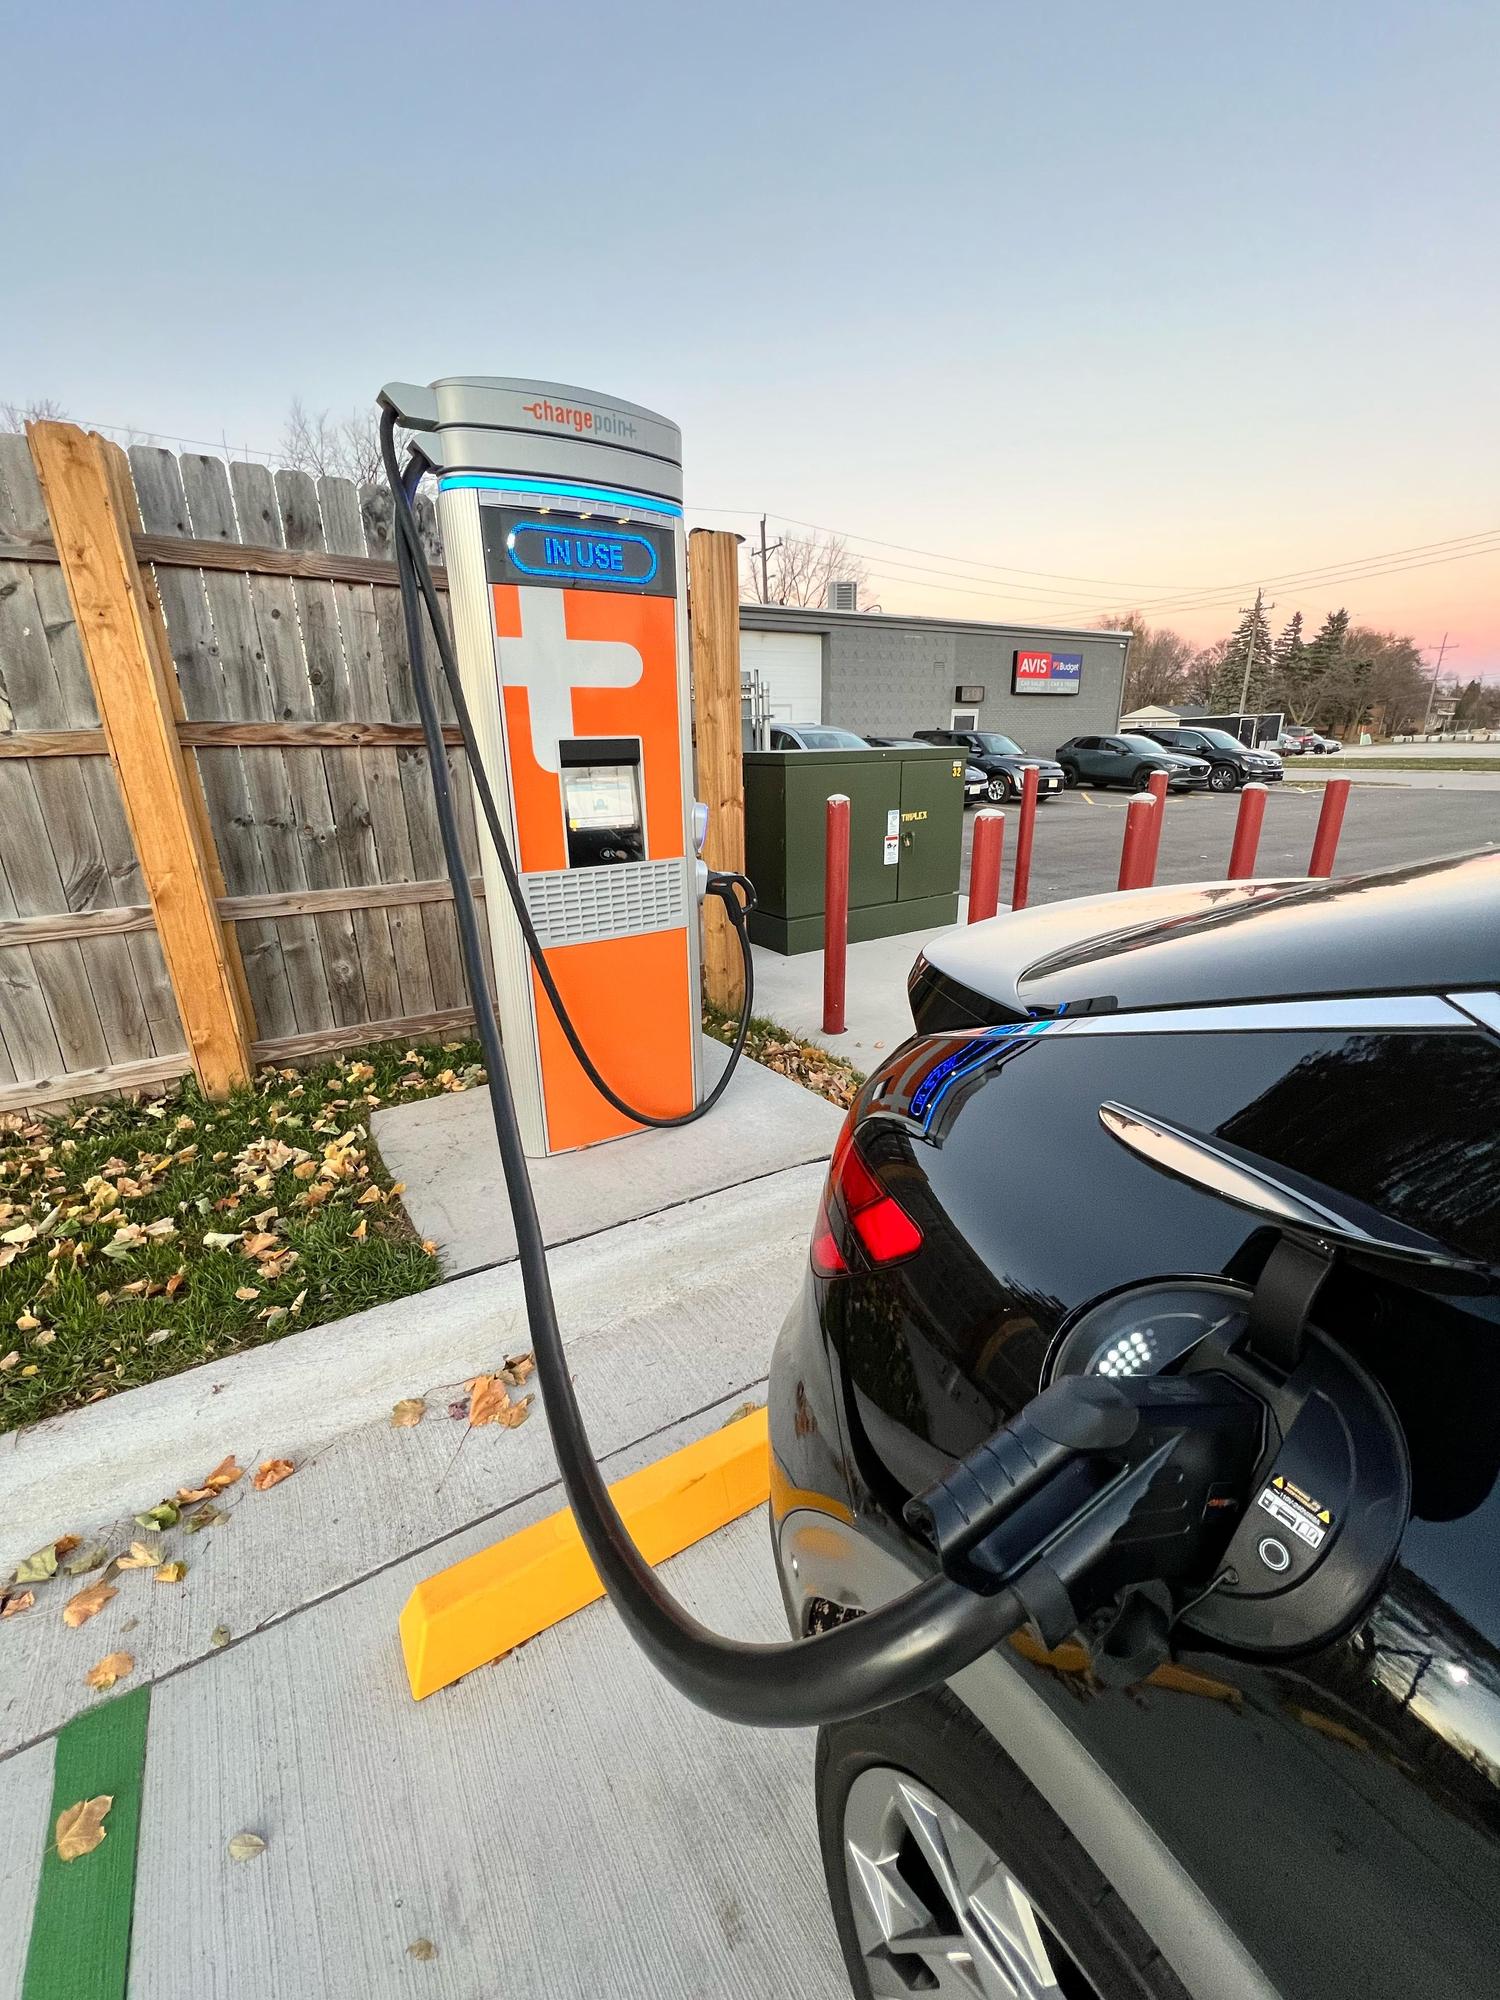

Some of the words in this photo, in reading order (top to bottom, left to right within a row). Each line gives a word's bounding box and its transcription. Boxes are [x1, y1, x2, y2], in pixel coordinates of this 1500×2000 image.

[544, 537, 571, 566] IN
[576, 541, 623, 571] USE
[1020, 658, 1047, 673] AVIS
[1059, 662, 1079, 673] Budget
[952, 767, 961, 777] 32
[901, 811, 928, 822] TRIPLEX
